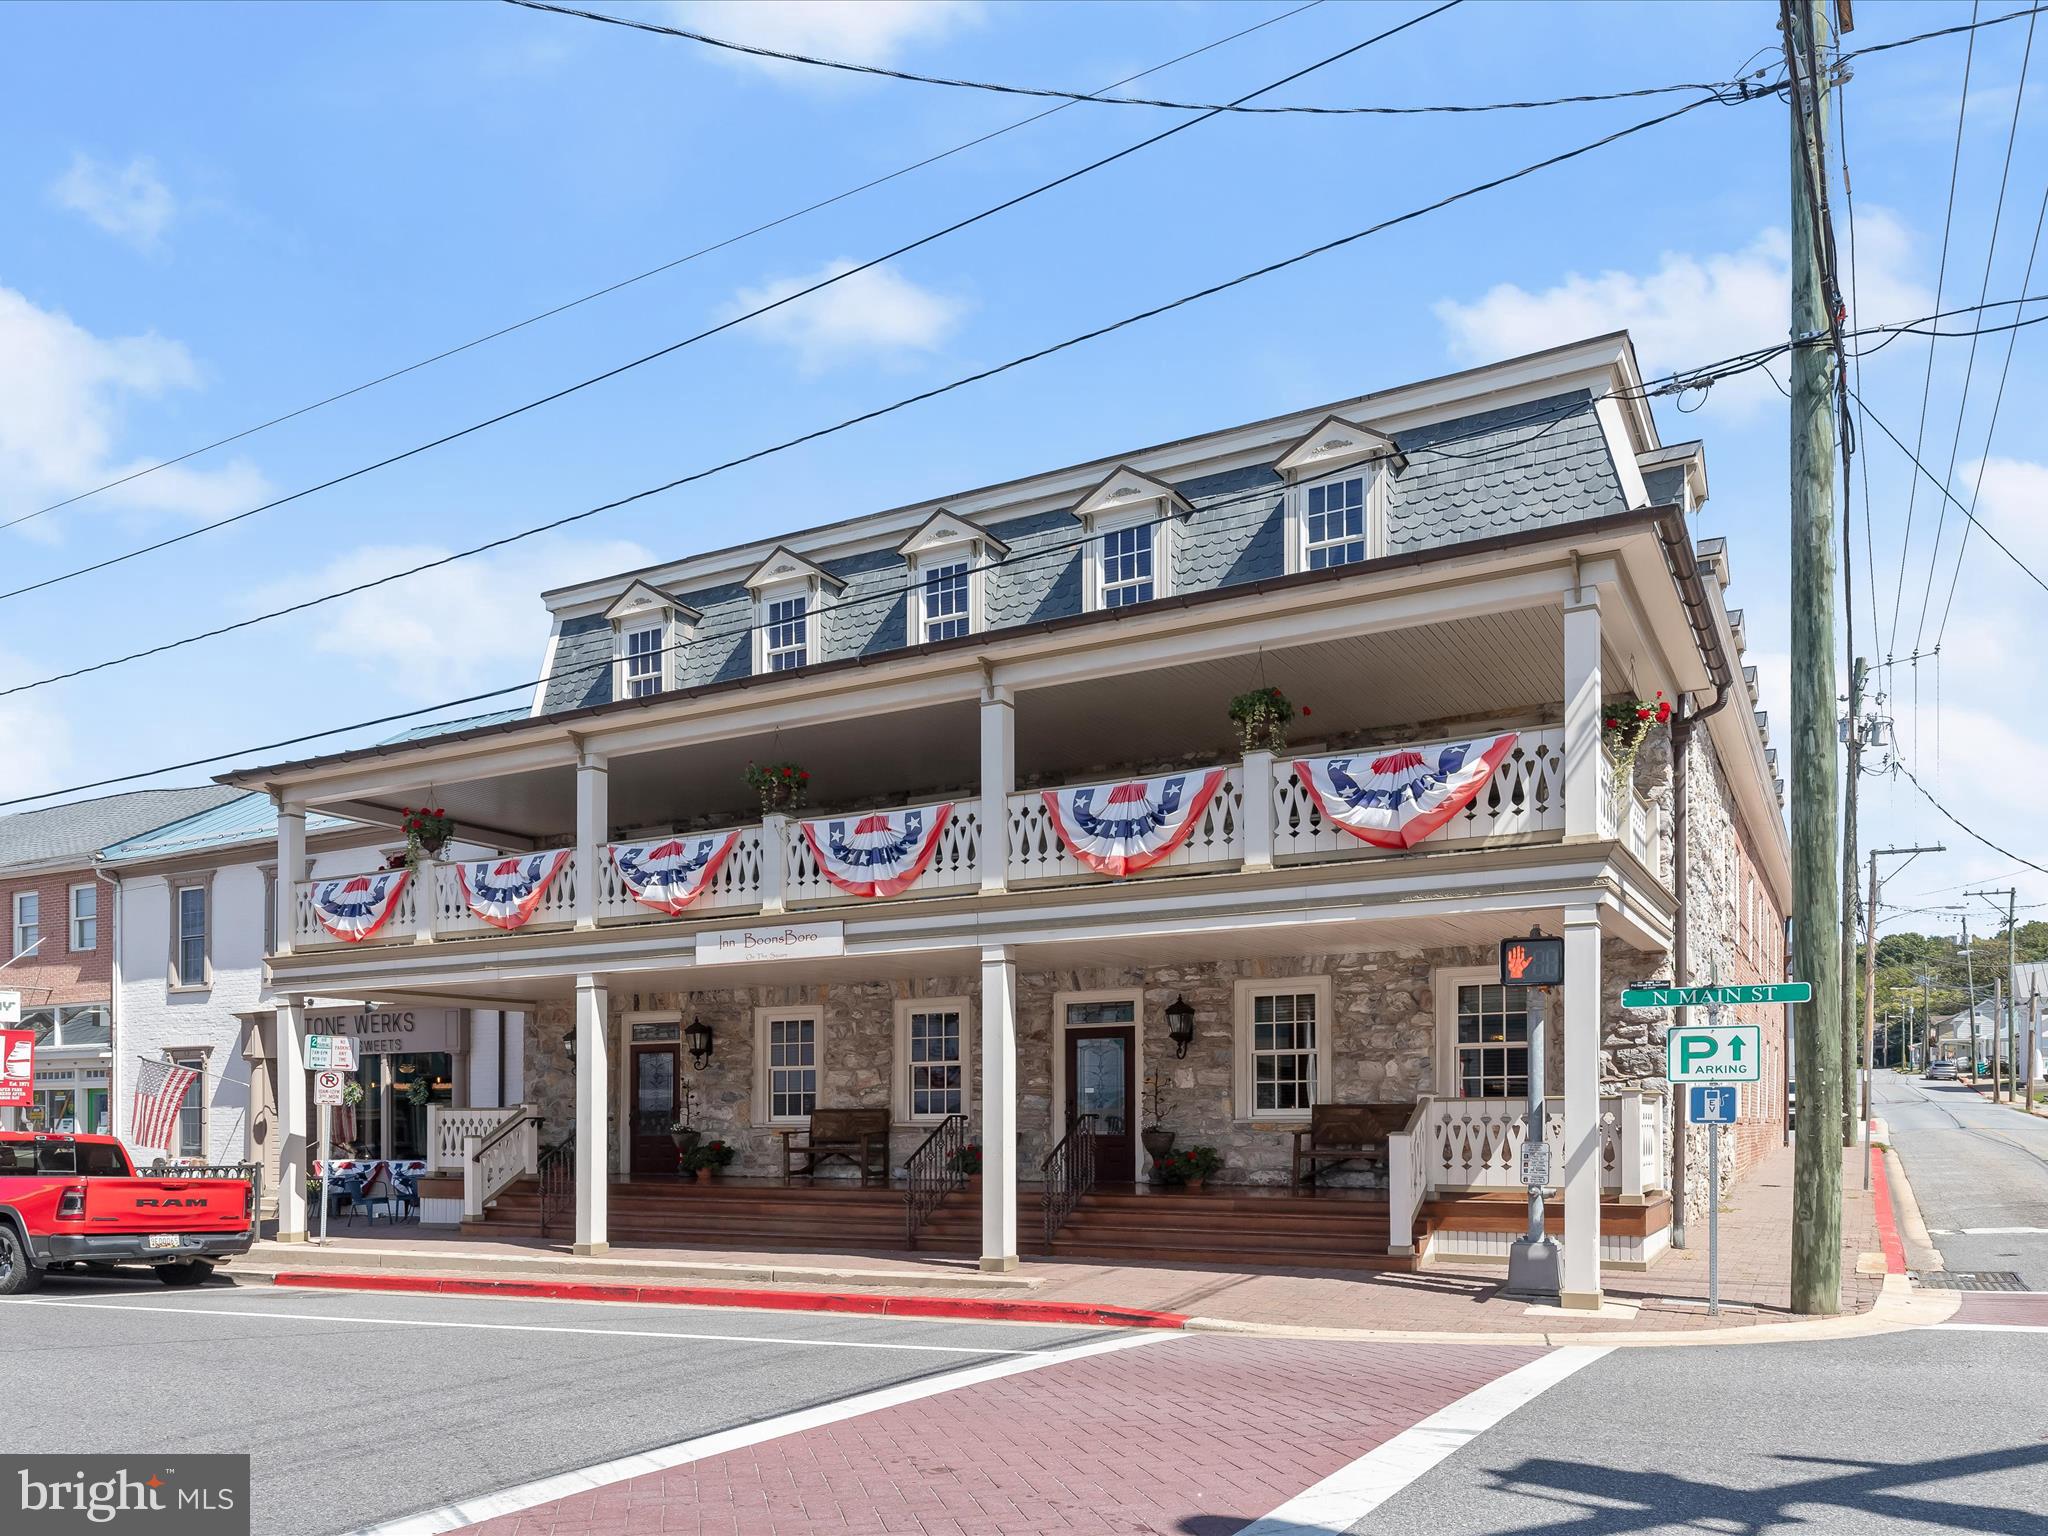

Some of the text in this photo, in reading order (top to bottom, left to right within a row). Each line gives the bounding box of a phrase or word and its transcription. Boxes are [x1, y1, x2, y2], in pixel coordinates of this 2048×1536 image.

[719, 929, 818, 950] Inn BoonsBoro
[1652, 986, 1778, 1005] N MAIN ST
[304, 1012, 415, 1036] TONE WERKS
[359, 1039, 402, 1052] SWEETS
[135, 1198, 208, 1207] RAM
